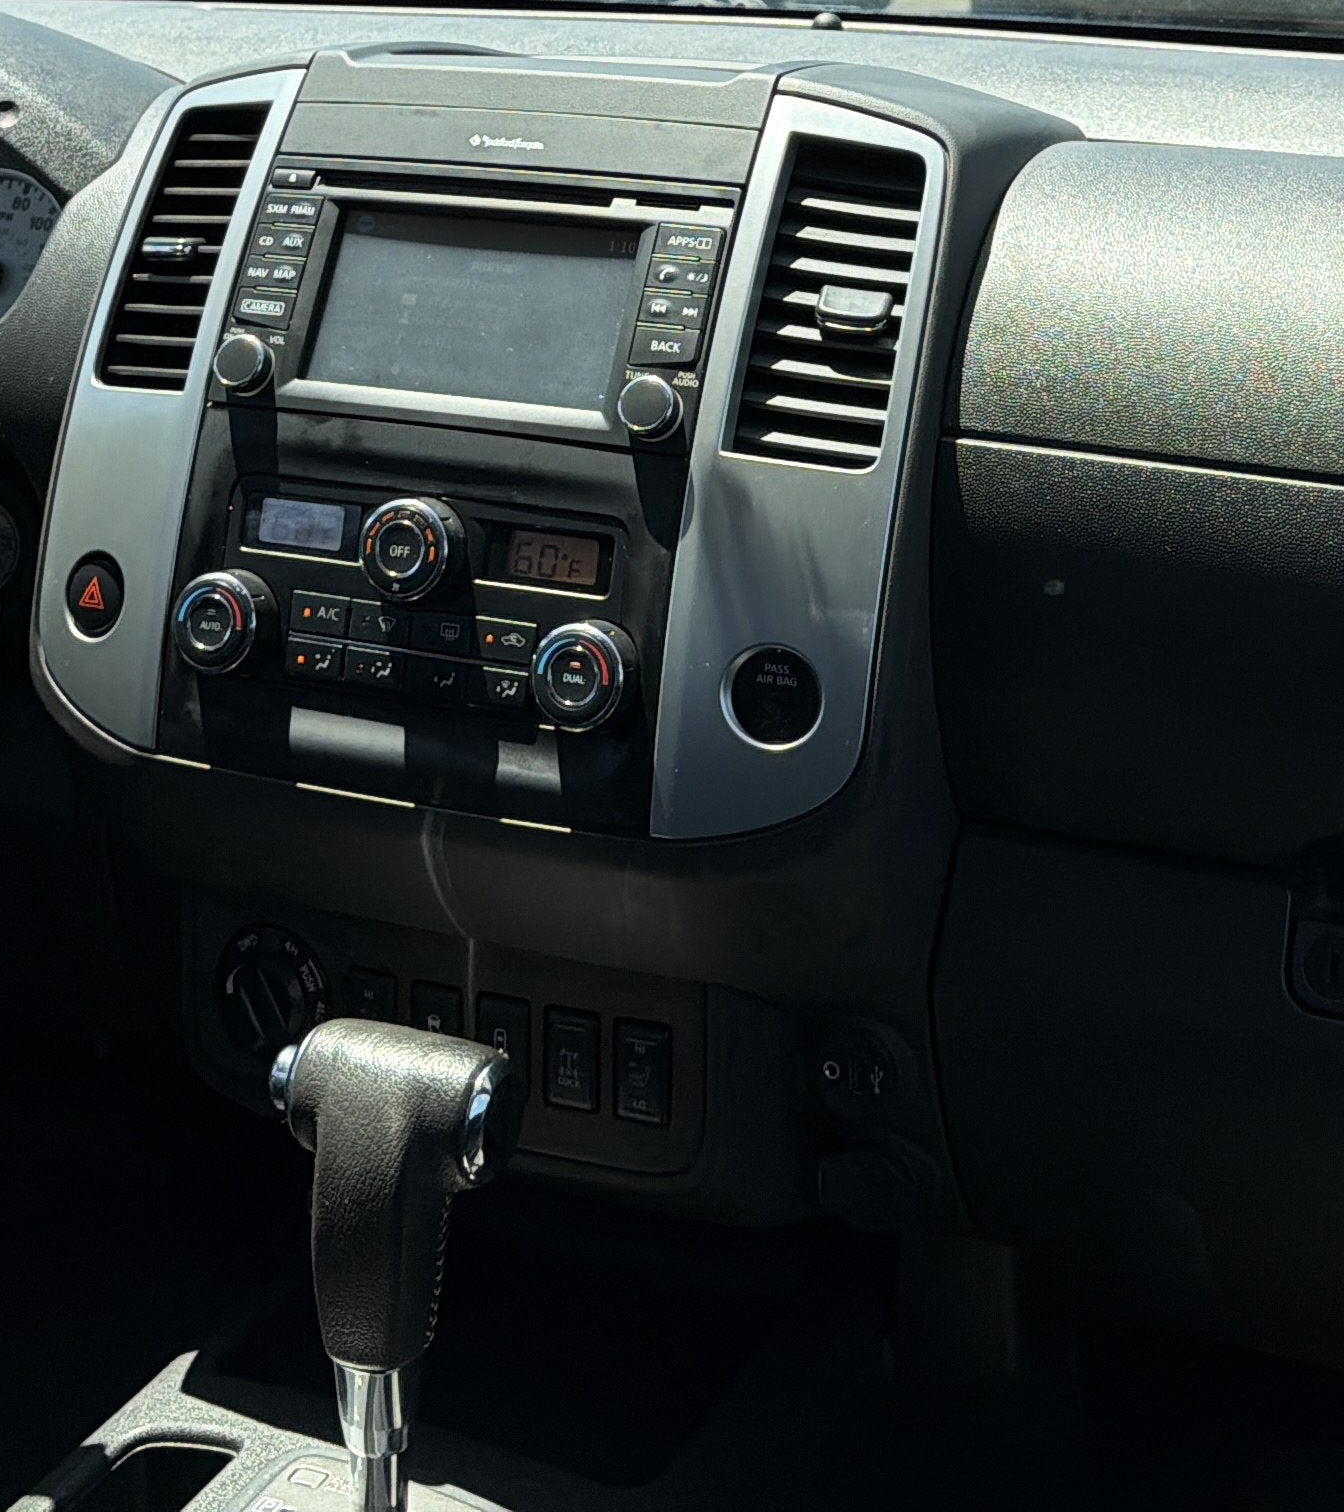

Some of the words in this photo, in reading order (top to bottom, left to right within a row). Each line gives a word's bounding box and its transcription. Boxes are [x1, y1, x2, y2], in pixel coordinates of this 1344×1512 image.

[12, 197, 31, 212] 80
[266, 203, 289, 214] SXM
[30, 217, 54, 232] 100
[258, 235, 274, 246] CD
[282, 236, 304, 247] AUX
[247, 267, 269, 278] NAV
[273, 268, 296, 280] MAP
[243, 300, 282, 313] CAMERA
[269, 335, 285, 345] VOL
[650, 340, 681, 354] BACK
[677, 370, 697, 380] PUSH
[671, 377, 700, 388] AUDIO
[389, 544, 411, 557] OFF
[316, 606, 341, 621] A/C
[199, 620, 222, 632] AUTO
[763, 663, 790, 675] PASS
[562, 673, 585, 685] DUAL
[756, 674, 774, 685] AIR
[776, 676, 798, 688] BAG
